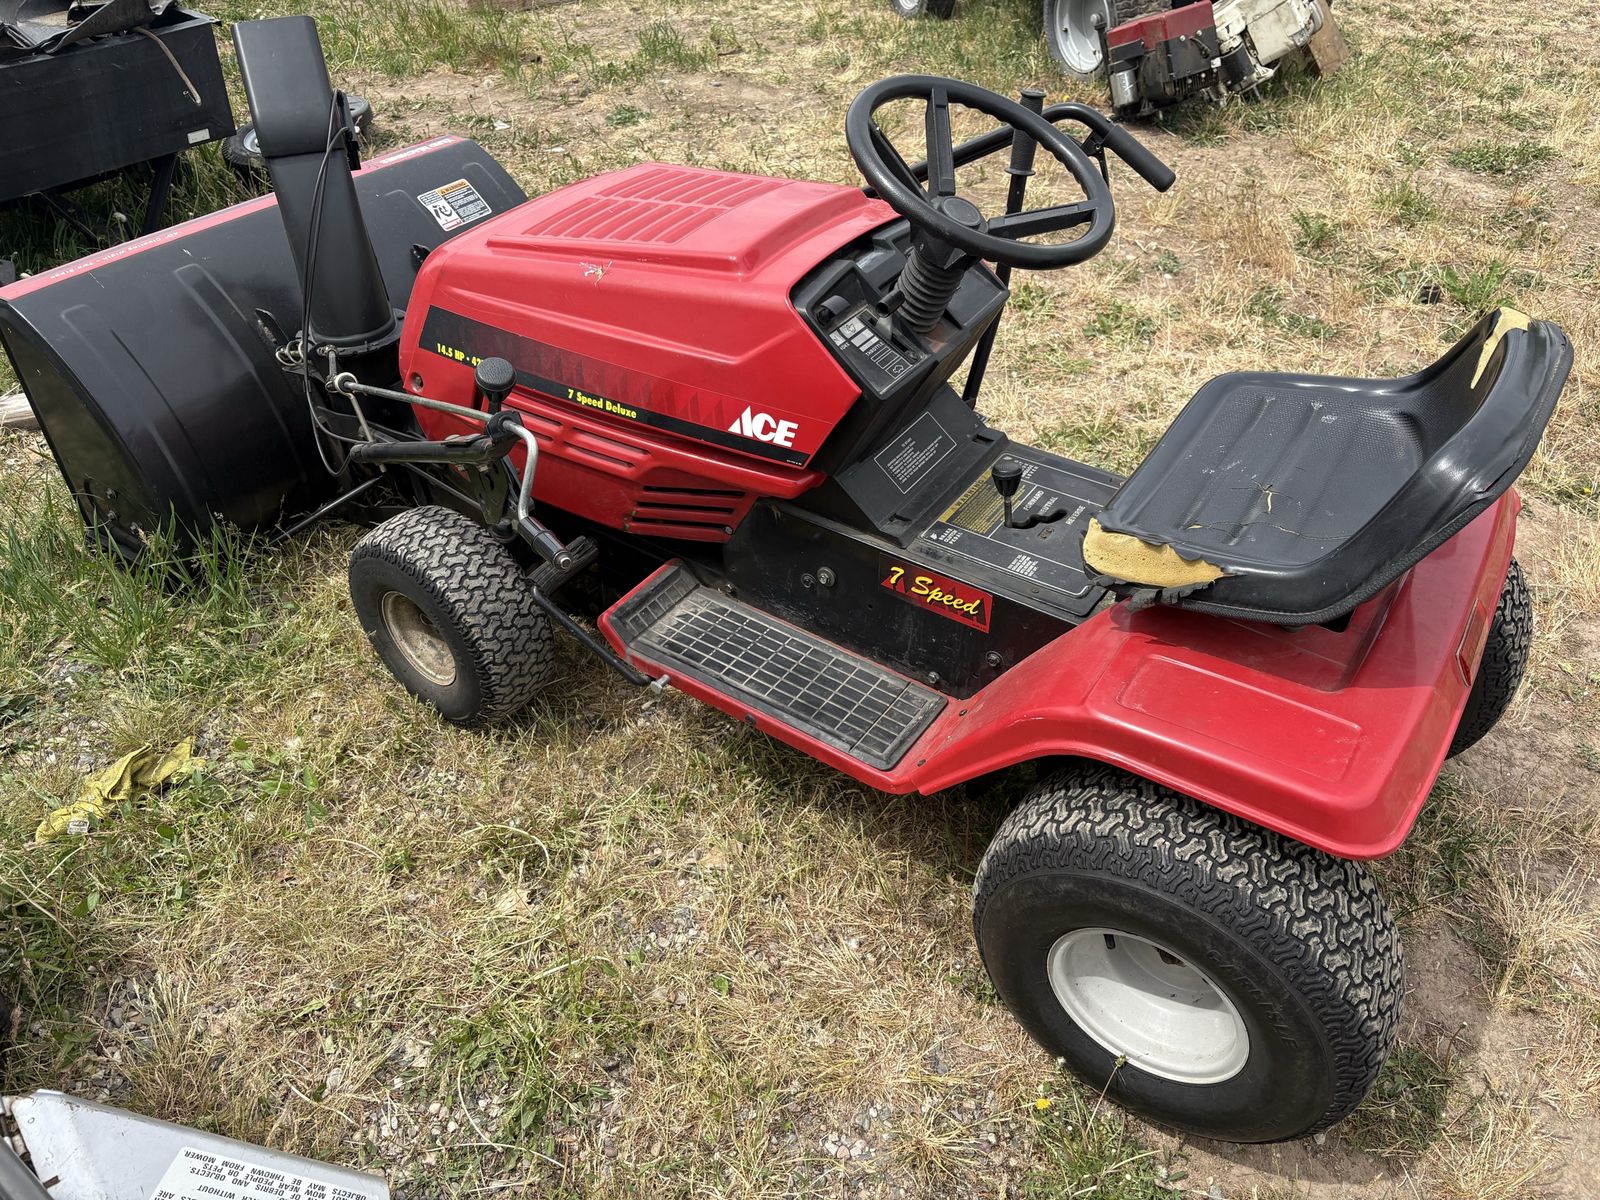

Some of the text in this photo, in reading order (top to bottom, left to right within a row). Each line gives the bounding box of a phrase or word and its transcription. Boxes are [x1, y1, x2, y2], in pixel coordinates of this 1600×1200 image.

[437, 343, 453, 357] 14.5
[454, 349, 465, 361] HP
[567, 388, 637, 419] 7 Speed Deluxe
[728, 405, 799, 448] ACE
[956, 478, 985, 508] WARNING
[1022, 489, 1045, 512] FORWARD
[1065, 504, 1087, 526] REVERSE
[890, 566, 980, 615] 7 Speed
[221, 1159, 246, 1172] FROM
[227, 1169, 240, 1178] OR
[244, 1173, 274, 1187] PEOPLE
[250, 1167, 286, 1182] THROWN
[189, 1165, 301, 1200] OF DEBRIS AND OBJECTS.
[278, 1182, 300, 1193] NEAR
[291, 1177, 303, 1186] BE
[307, 1181, 326, 1192] MAY
[157, 1189, 175, 1199] ARE
[196, 1184, 235, 1200] WITHOUT
[304, 1189, 327, 1200] MOW
[331, 1188, 367, 1200] OBJECTS
